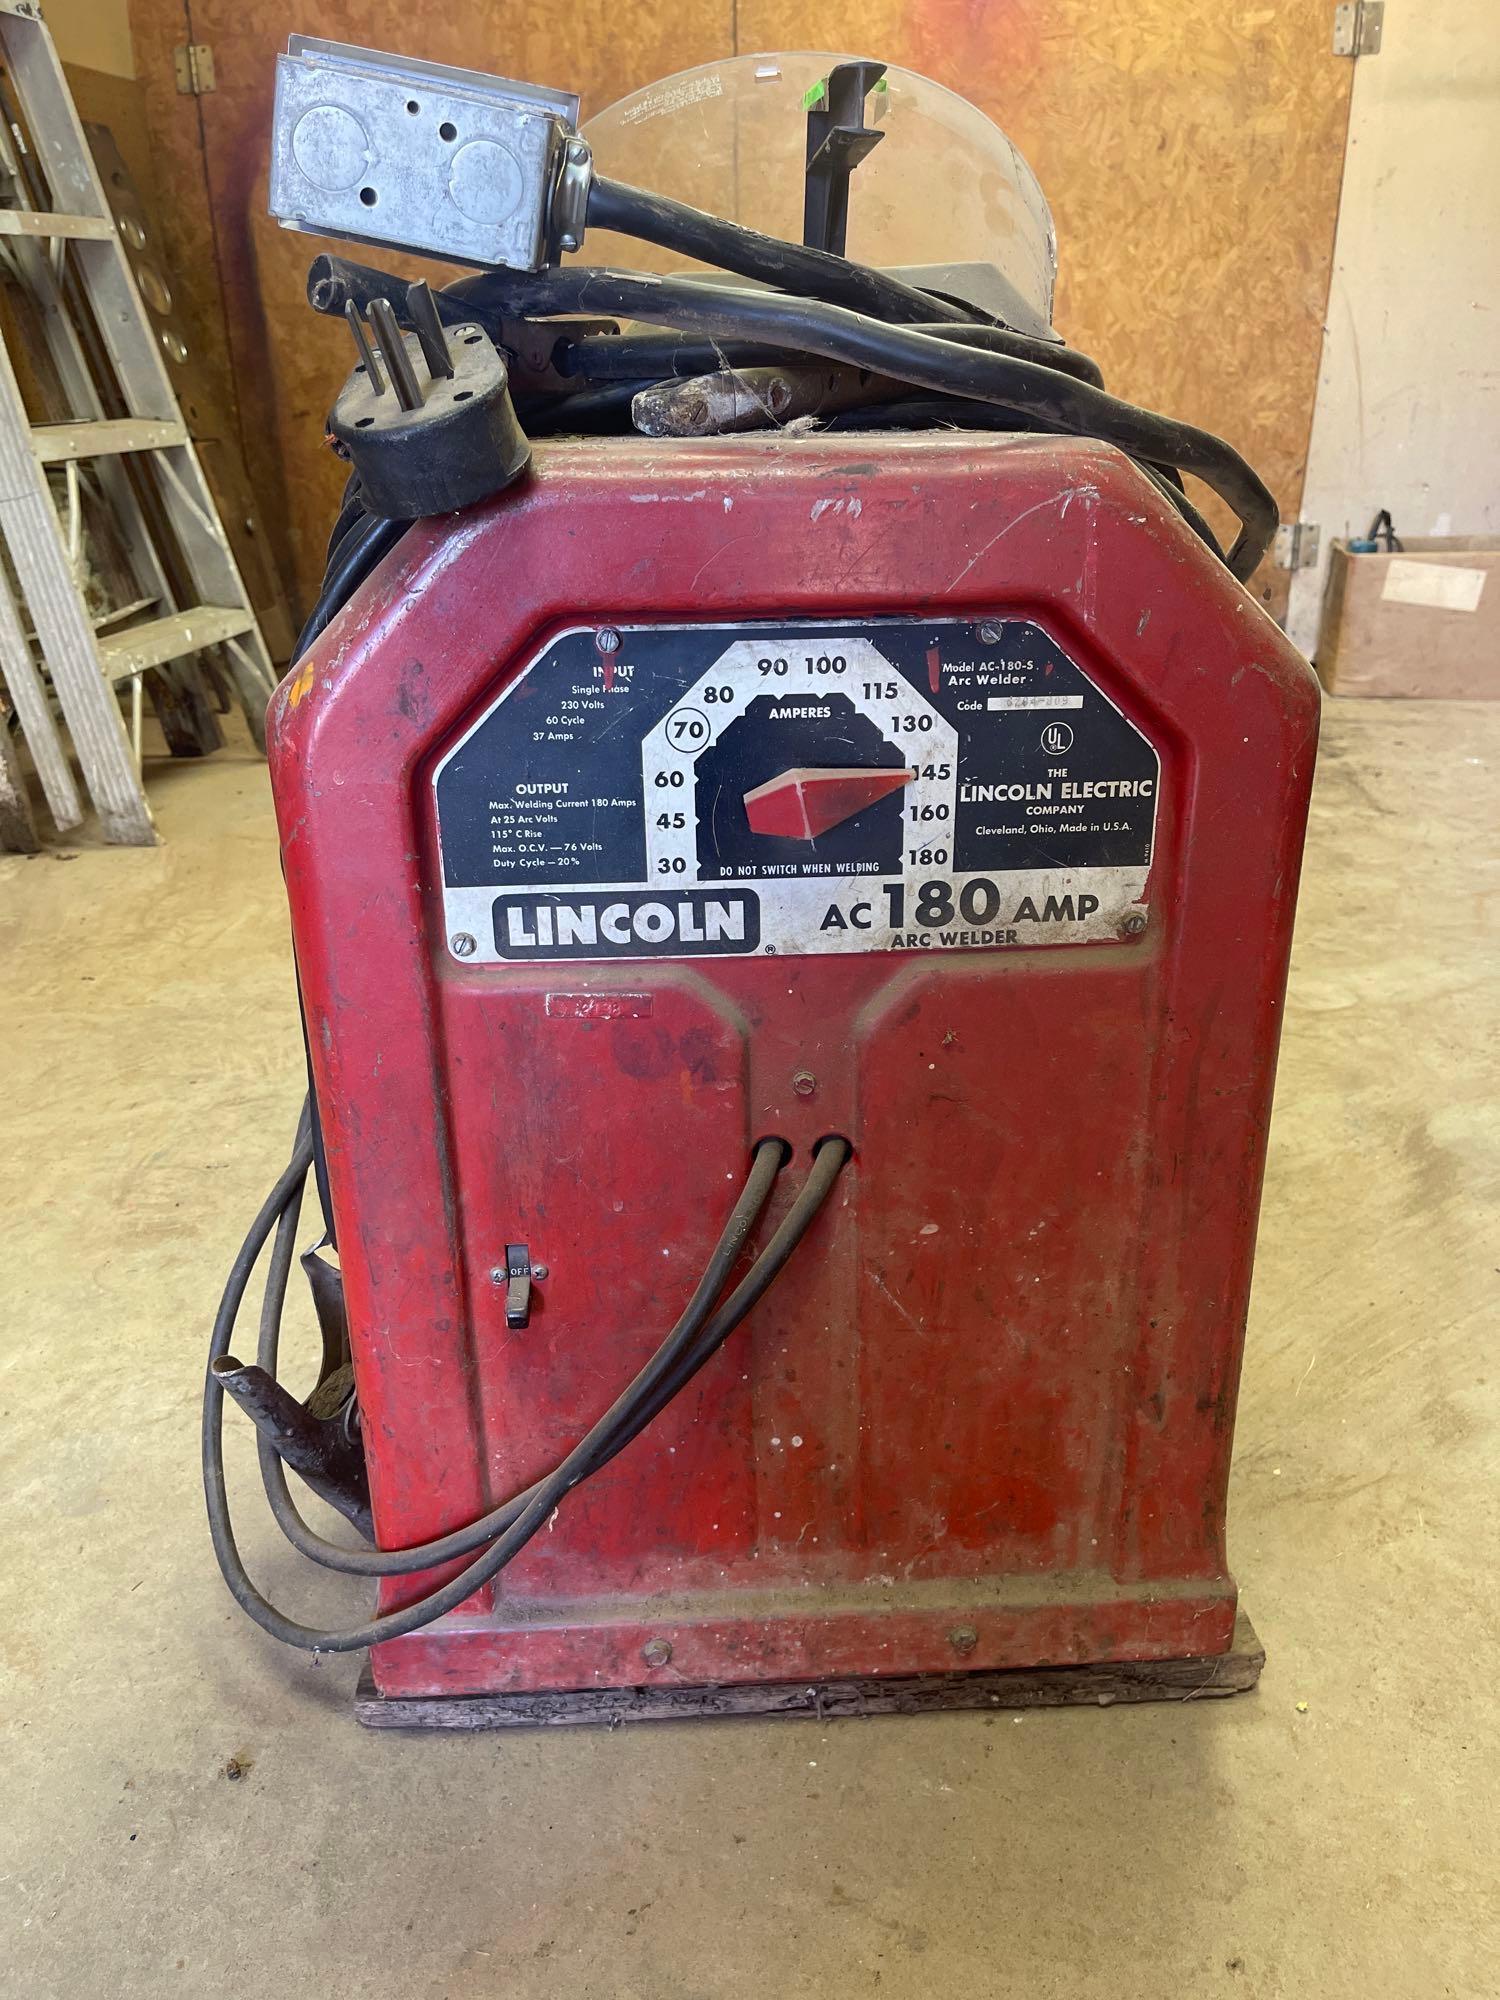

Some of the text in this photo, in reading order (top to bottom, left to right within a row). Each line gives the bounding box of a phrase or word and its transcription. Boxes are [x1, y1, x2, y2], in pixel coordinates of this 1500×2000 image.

[593, 666, 635, 677] INUT
[758, 658, 788, 676] 90
[805, 656, 846, 674] 100
[943, 659, 1034, 672] Model AC-180-S
[948, 674, 1027, 685] Arc Welder
[572, 685, 601, 696] Single
[704, 686, 734, 703] 80
[863, 682, 898, 699] 115
[561, 700, 605, 710] 230 Volts
[957, 701, 983, 710] Code
[769, 707, 831, 719] AMPERES
[545, 715, 585, 726] 60 Cycle
[892, 715, 932, 732] 130
[532, 731, 574, 741] 37 Amps
[674, 722, 703, 738] 70
[911, 764, 951, 781] 145
[1047, 768, 1068, 778] THE
[655, 772, 684, 787] 60
[516, 783, 569, 794] OUTPUT
[961, 780, 1152, 802] LINCOLN ELECTRIC
[489, 798, 638, 810] Max. Welding Current 180 Amps
[1026, 805, 1085, 815] COMPANY
[490, 814, 558, 824] At 25 Arc Volts
[910, 804, 949, 821] 160
[657, 813, 685, 829] 45
[515, 829, 523, 839] C
[524, 829, 543, 838] Rise
[976, 822, 1133, 835] Cleveland, Ohio, Made in U.S.A.
[493, 844, 517, 853] Max.
[517, 843, 549, 853] O.C.V.
[564, 842, 578, 852] 76
[579, 842, 603, 851] Volts
[493, 859, 516, 869] Duty
[520, 858, 546, 868] Cycle
[557, 857, 580, 866] 20%
[909, 850, 948, 866] 180
[658, 857, 686, 874] 30
[720, 862, 880, 876] DO NOT SWITCH WHEN WELDING
[820, 878, 1099, 930] AC 180 AMP
[507, 901, 745, 946] LINCOLN
[891, 930, 1017, 948] ARC WELDER
[509, 1267, 529, 1277] OFF
